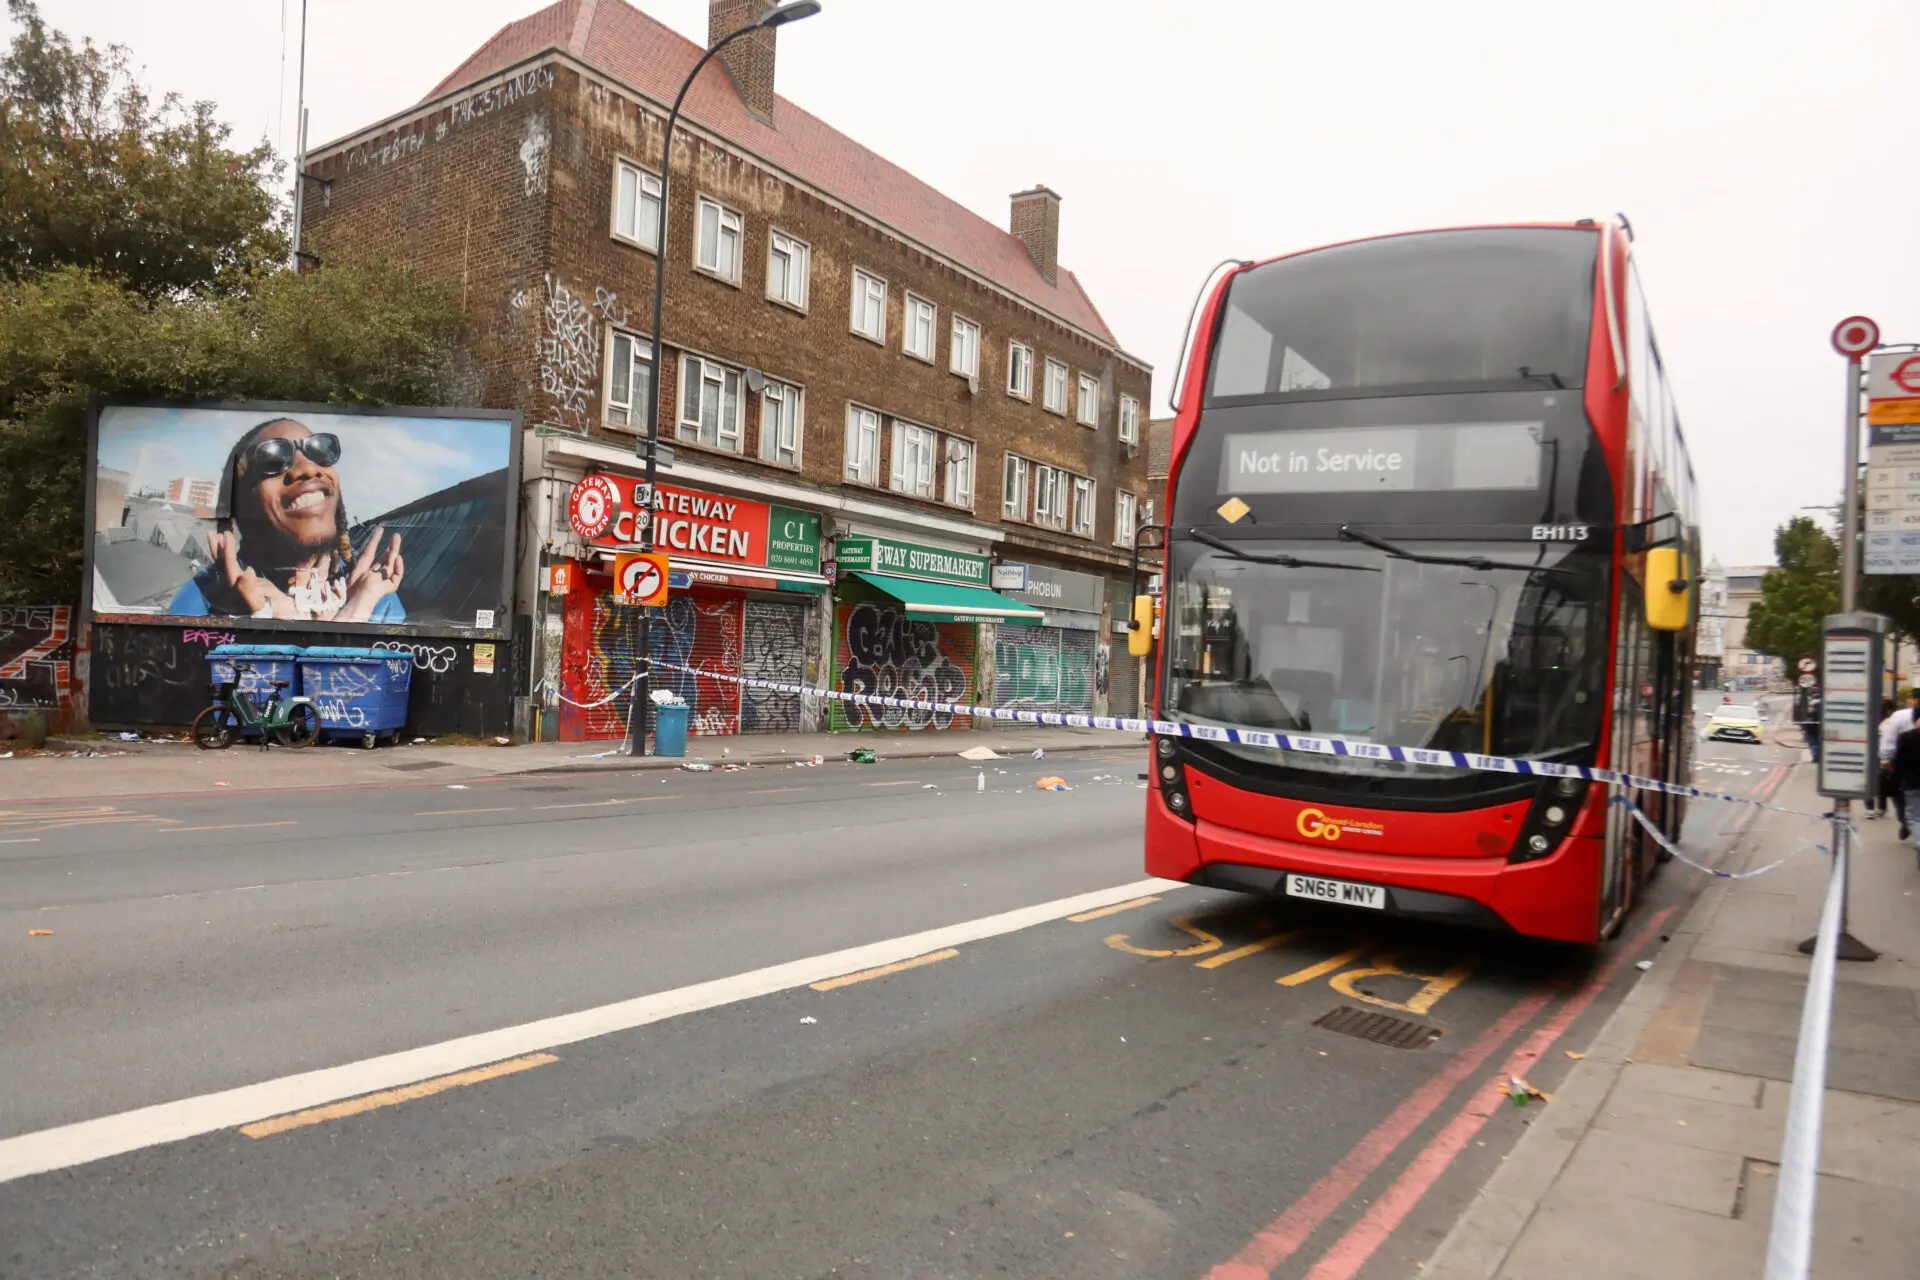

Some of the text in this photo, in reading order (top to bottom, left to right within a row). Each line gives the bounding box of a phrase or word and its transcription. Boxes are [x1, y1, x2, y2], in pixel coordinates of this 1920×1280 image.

[1239, 447, 1403, 474] Not in Service
[572, 477, 612, 502] GATEWAY
[654, 490, 737, 521] ATEWAY
[571, 513, 609, 537] CHICKEN
[637, 515, 647, 525] 20
[1531, 526, 1589, 540] EH113
[772, 540, 814, 553] PROPERTIES
[770, 555, 814, 567] 020 8691 4050
[878, 545, 984, 579] EWAY SUPERMARKET
[700, 572, 729, 583] CHICKEN
[1296, 808, 1341, 841] Go
[1294, 877, 1376, 904] SN66 WNY
